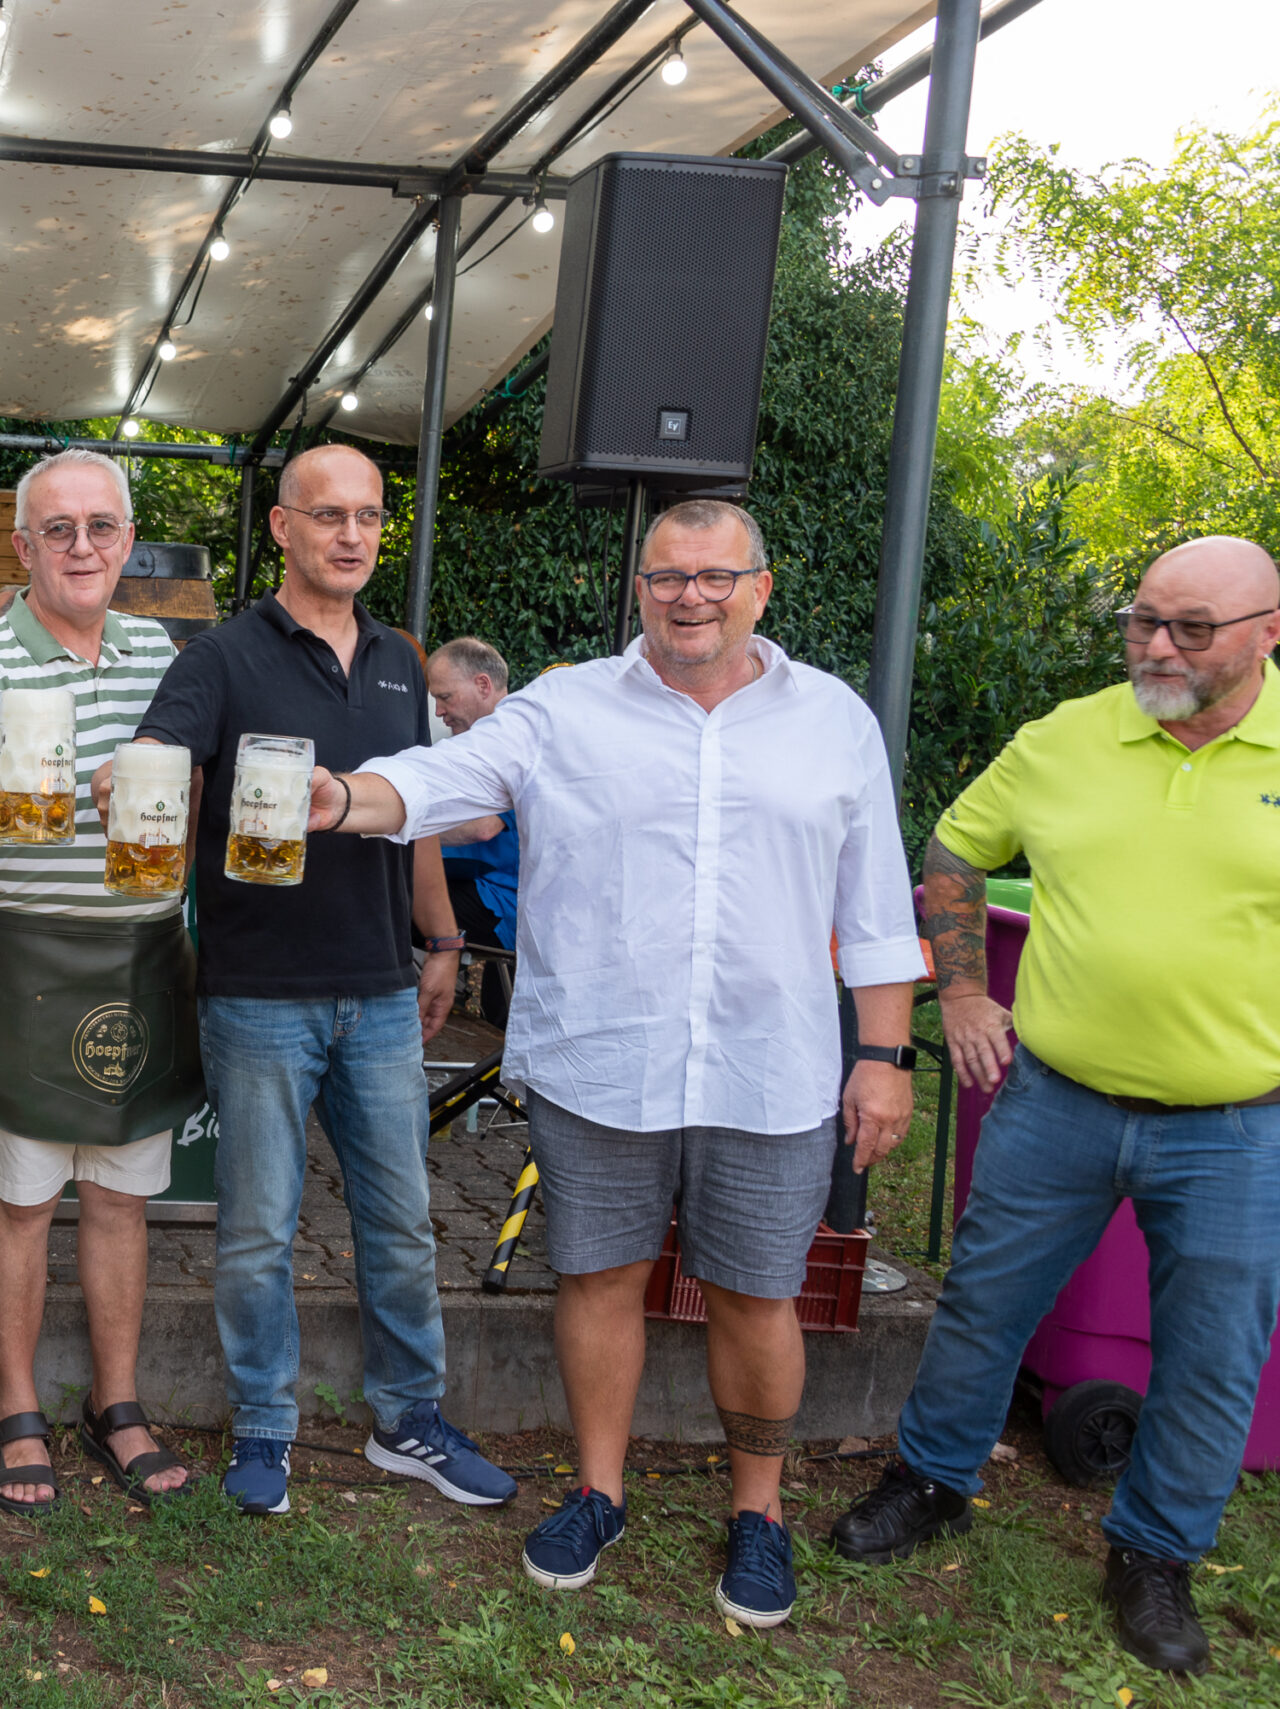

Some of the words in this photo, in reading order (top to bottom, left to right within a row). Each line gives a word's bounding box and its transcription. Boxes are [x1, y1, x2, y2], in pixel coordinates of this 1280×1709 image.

[241, 797, 277, 810] Hoepfner
[140, 812, 177, 823] Hoepfner
[85, 1041, 141, 1061] Hoepfner
